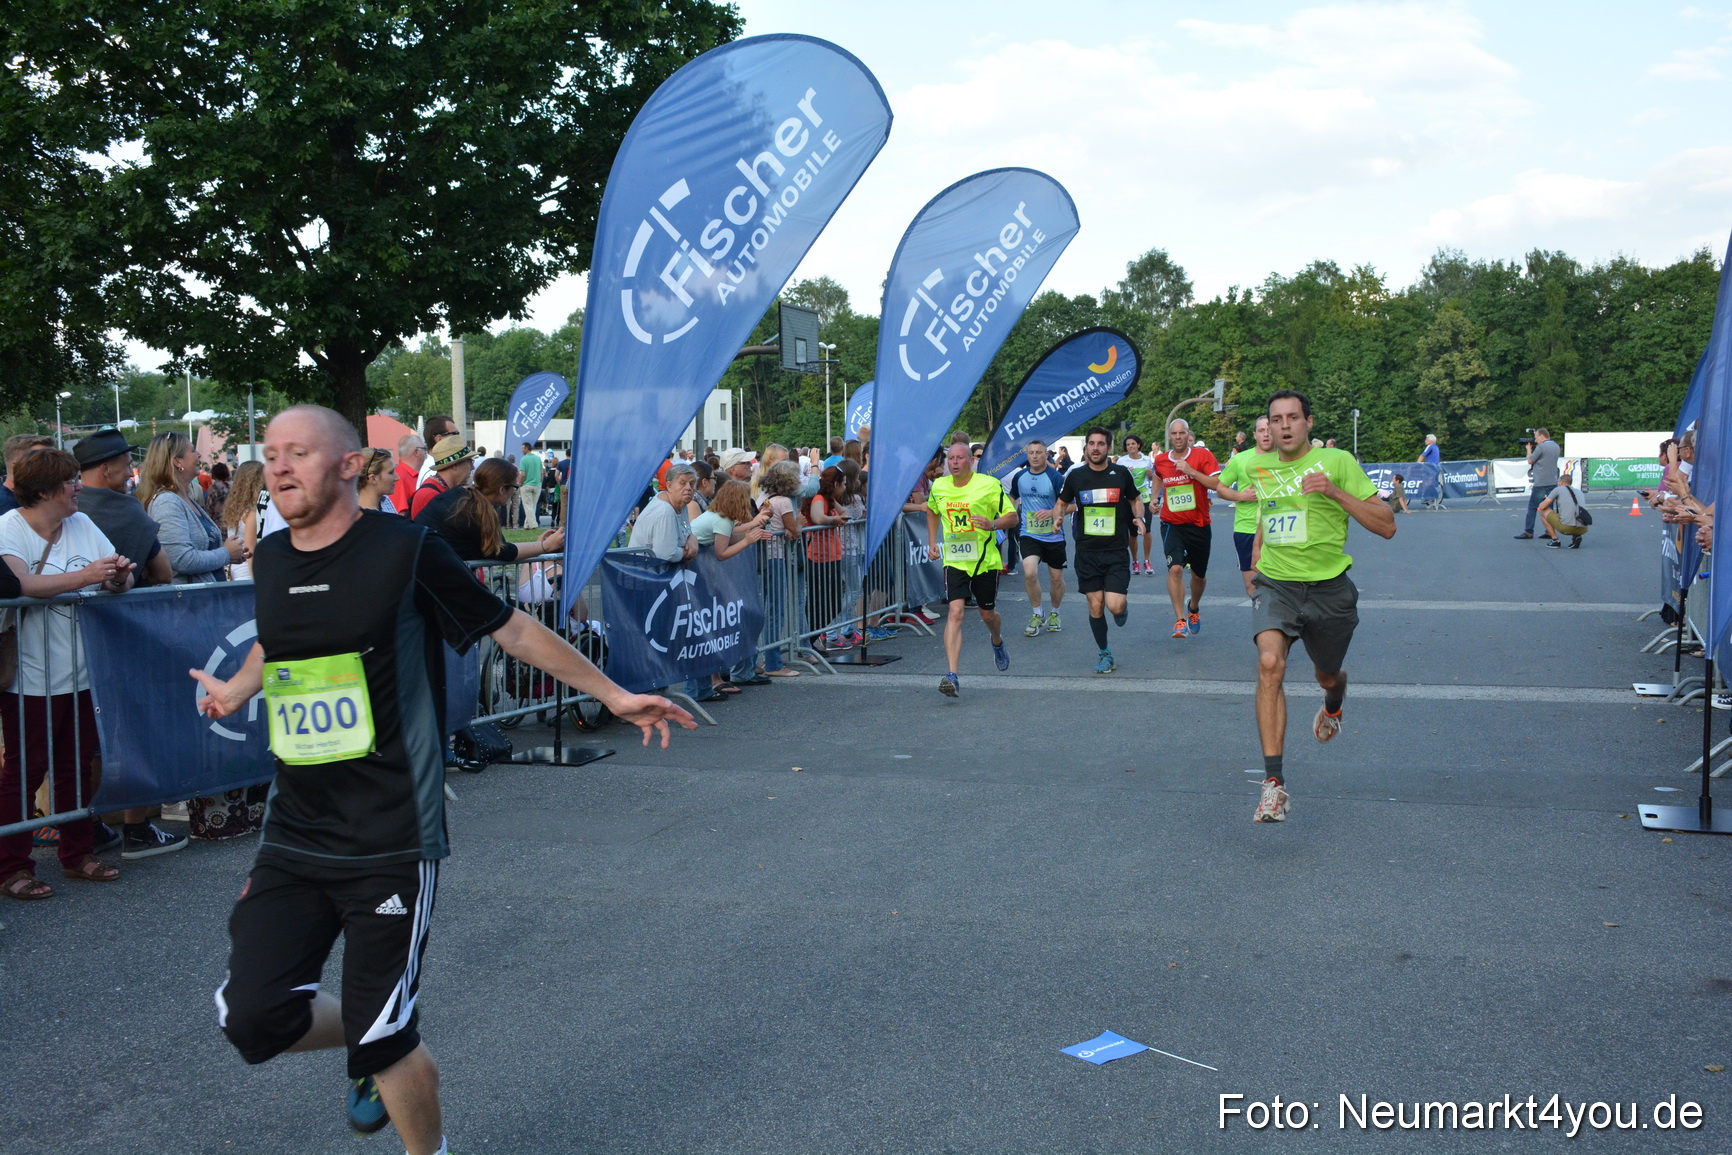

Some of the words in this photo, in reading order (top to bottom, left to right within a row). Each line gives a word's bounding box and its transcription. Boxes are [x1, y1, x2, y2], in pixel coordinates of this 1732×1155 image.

[659, 87, 824, 308] Fischer
[714, 129, 842, 306] AUTOMOBILE
[924, 200, 1033, 355] Fischer
[962, 228, 1046, 352] AUTOMOBILE
[520, 382, 556, 430] Fischer
[1004, 376, 1100, 441] Frischmann
[1066, 395, 1090, 414] Druck
[1104, 369, 1132, 391] Medien
[533, 391, 560, 429] AUTOMOBILE
[1443, 472, 1479, 484] Frischmann
[1594, 463, 1620, 477] AOK
[1169, 494, 1193, 505] 1399
[954, 515, 967, 527] M
[1028, 519, 1050, 528] 1327
[1093, 518, 1105, 528] 41
[1268, 515, 1297, 533] 217
[951, 543, 972, 554] 340
[669, 596, 744, 641] Fischer
[677, 631, 740, 661] AUTOMOBILE
[277, 696, 358, 736] 1200
[375, 906, 408, 915] adidas
